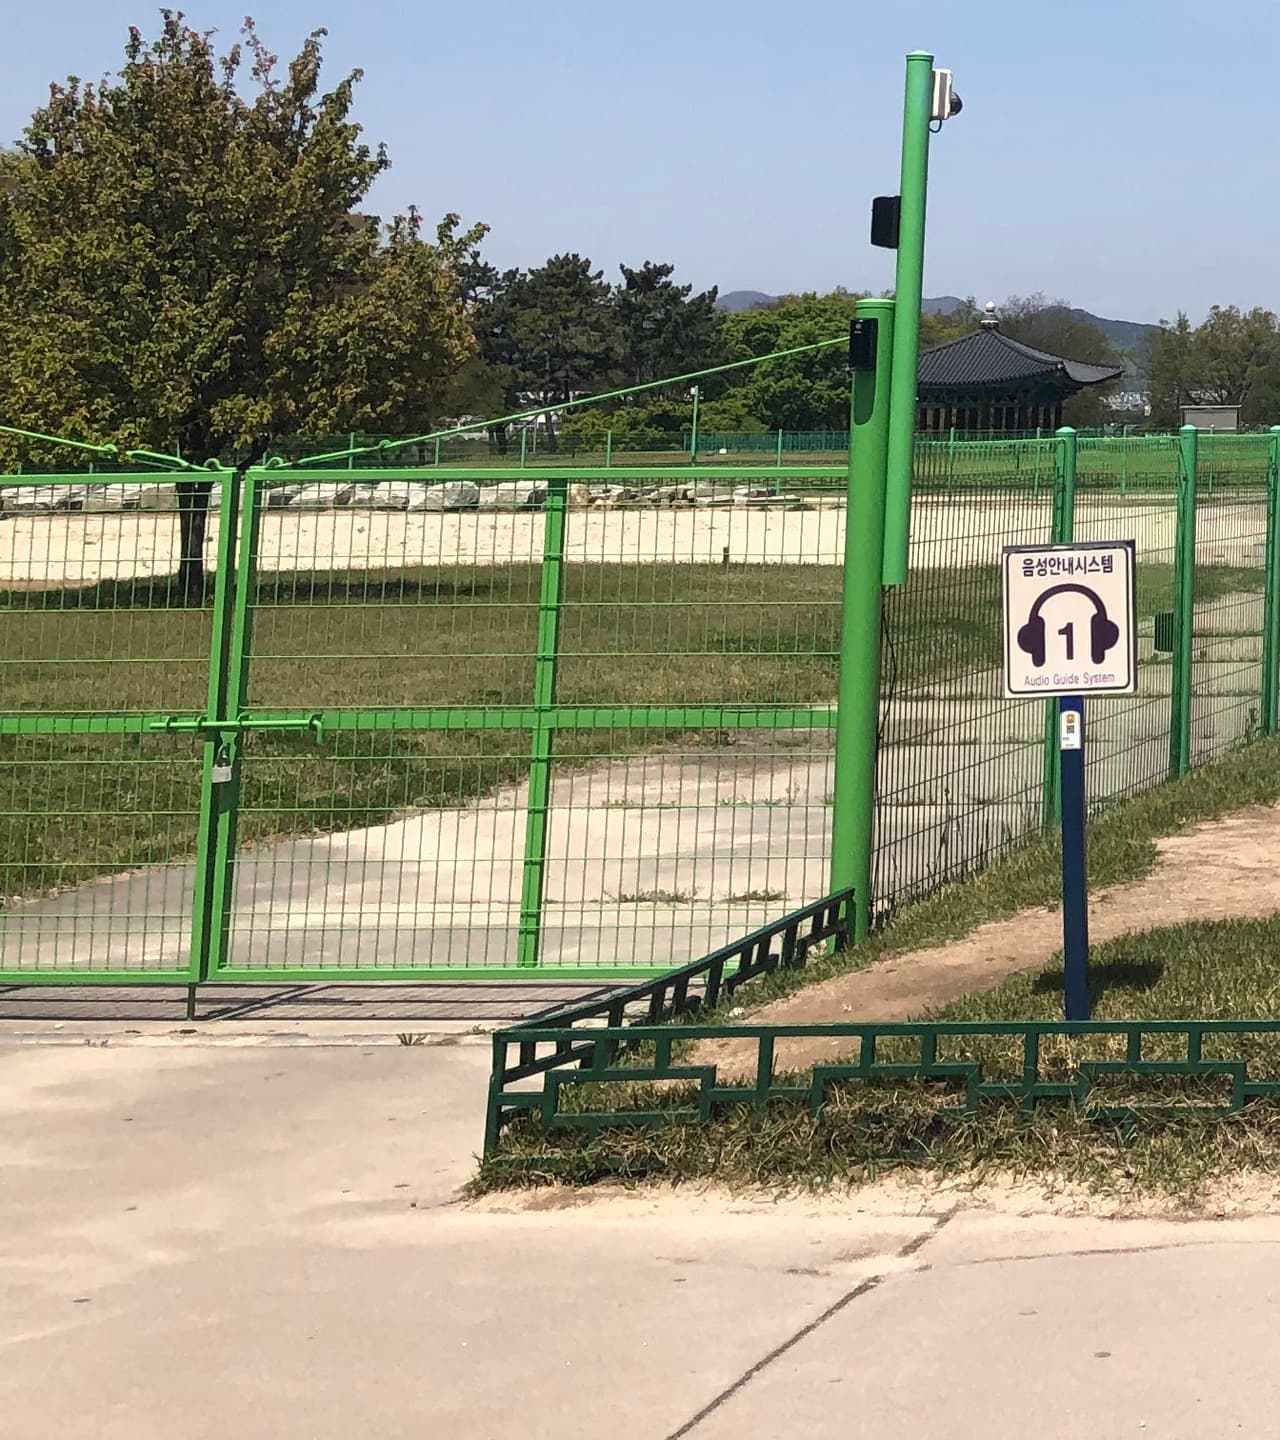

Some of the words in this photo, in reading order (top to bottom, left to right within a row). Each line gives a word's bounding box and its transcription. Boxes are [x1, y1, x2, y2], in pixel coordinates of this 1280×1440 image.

[1022, 555, 1113, 577] 음성안내시스템
[1058, 622, 1074, 660] 1
[1024, 675, 1049, 686] Audio
[1053, 674, 1079, 684] Guide
[1083, 672, 1115, 685] System
